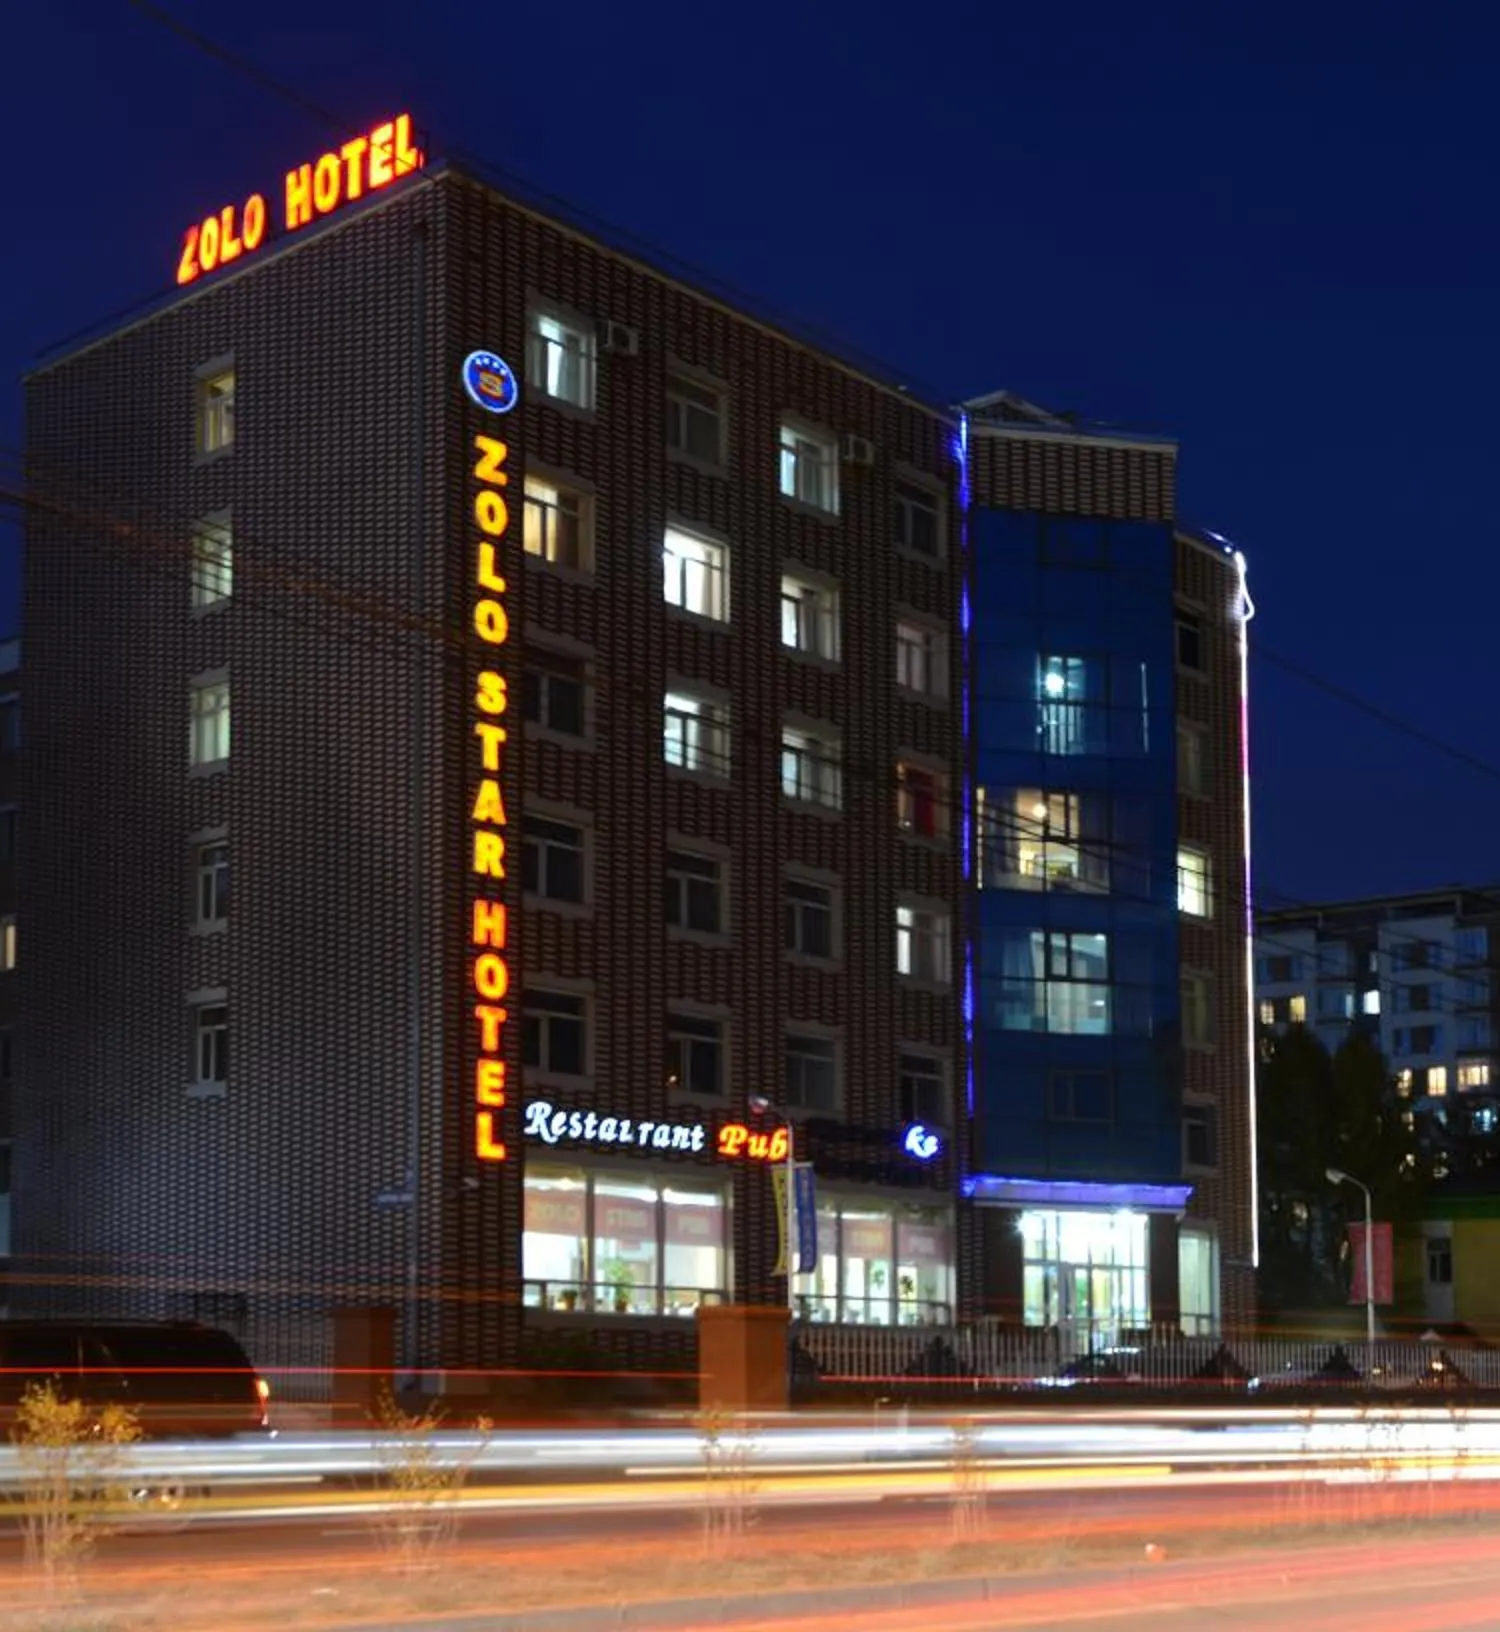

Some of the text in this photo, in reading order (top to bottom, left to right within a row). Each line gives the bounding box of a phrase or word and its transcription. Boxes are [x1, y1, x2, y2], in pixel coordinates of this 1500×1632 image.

[177, 113, 418, 285] ZOLO HOTEL
[472, 435, 509, 1161] ZOLO STAR HOTEL
[717, 1123, 787, 1161] Pub
